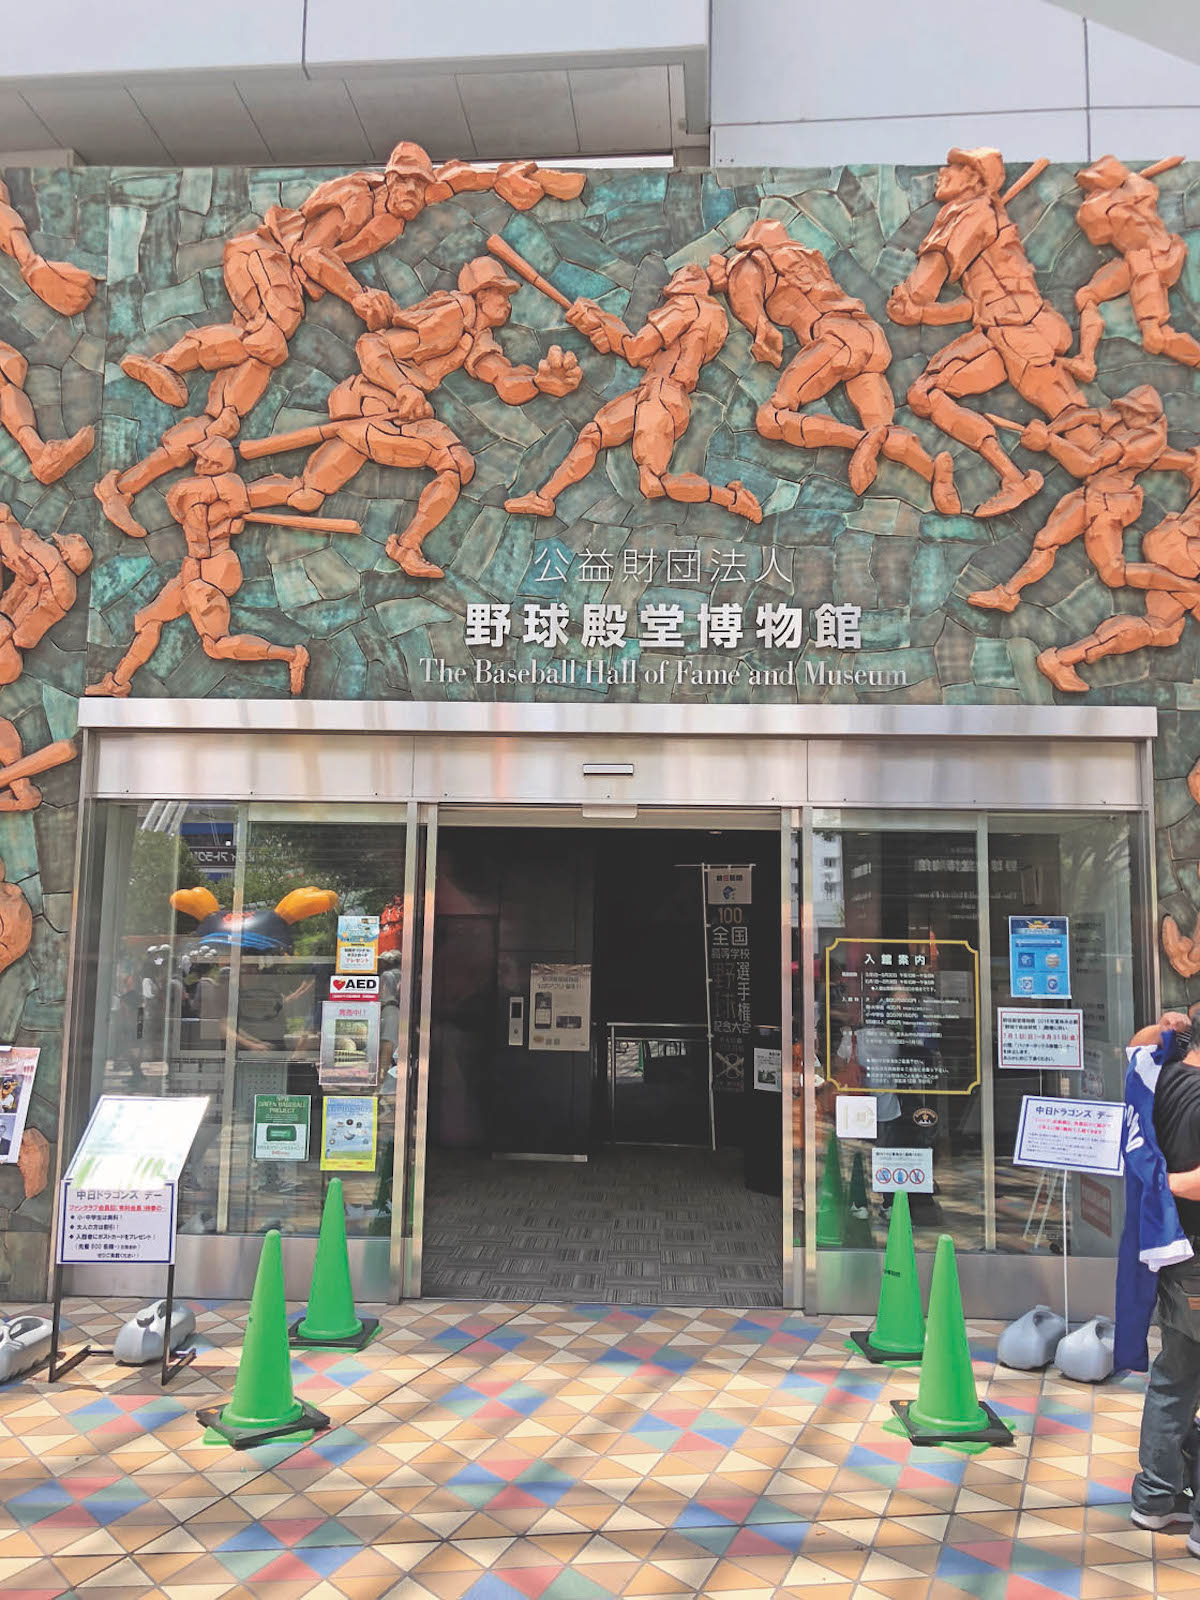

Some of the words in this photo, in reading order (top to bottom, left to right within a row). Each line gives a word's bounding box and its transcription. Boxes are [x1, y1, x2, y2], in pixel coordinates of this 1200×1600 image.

[534, 547, 794, 584] 公益財団法人
[464, 602, 862, 650] 野球殿堂博物館
[419, 658, 467, 684] The
[474, 658, 576, 684] Baseball
[585, 658, 637, 684] Hall
[644, 660, 670, 685] of
[676, 660, 740, 686] Fame
[748, 661, 796, 686] and
[803, 660, 908, 686] Museum
[712, 926, 748, 946] 全国
[345, 979, 377, 989] AED
